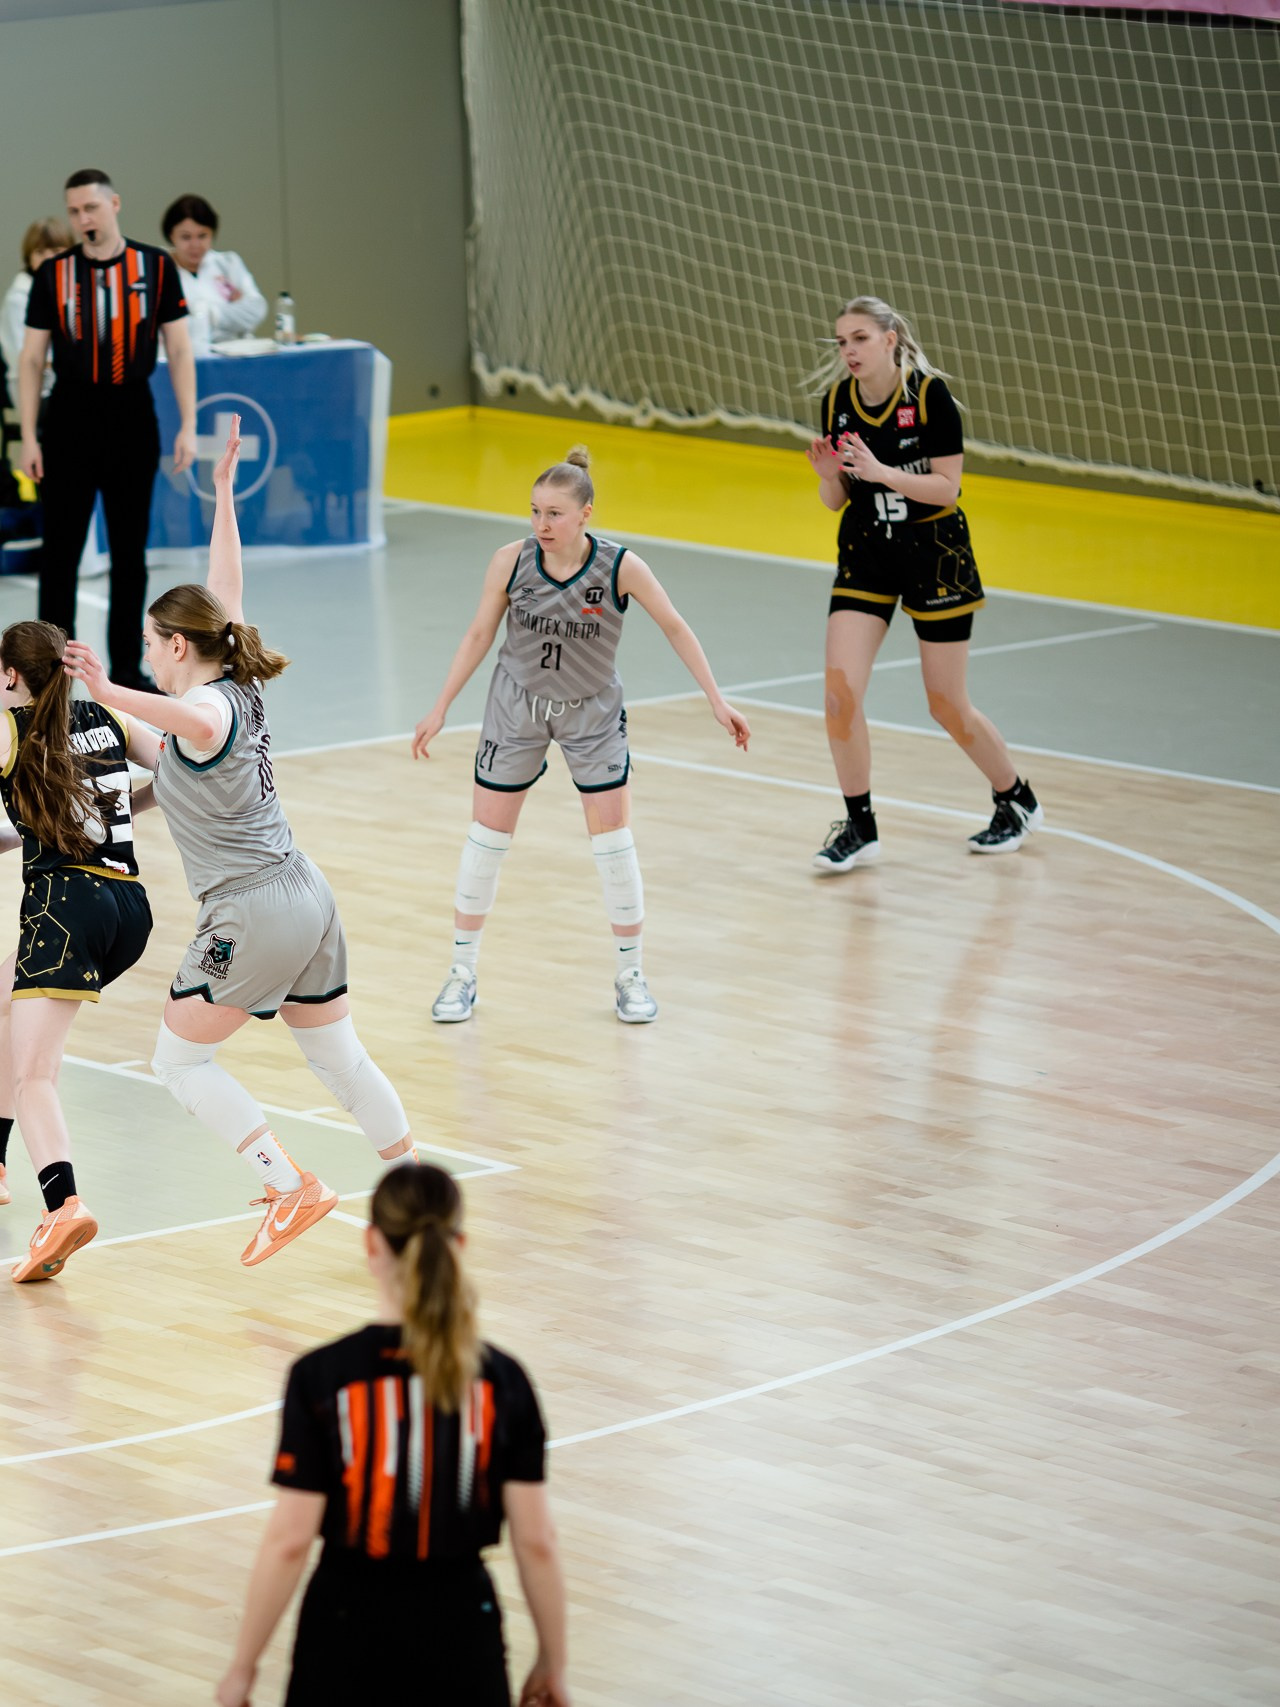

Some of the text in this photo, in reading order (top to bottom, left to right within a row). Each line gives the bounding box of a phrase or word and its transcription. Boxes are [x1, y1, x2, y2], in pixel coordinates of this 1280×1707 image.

[874, 492, 908, 522] 15
[565, 621, 600, 640] ПЕТРА
[540, 642, 562, 671] 21
[479, 739, 499, 772] 21
